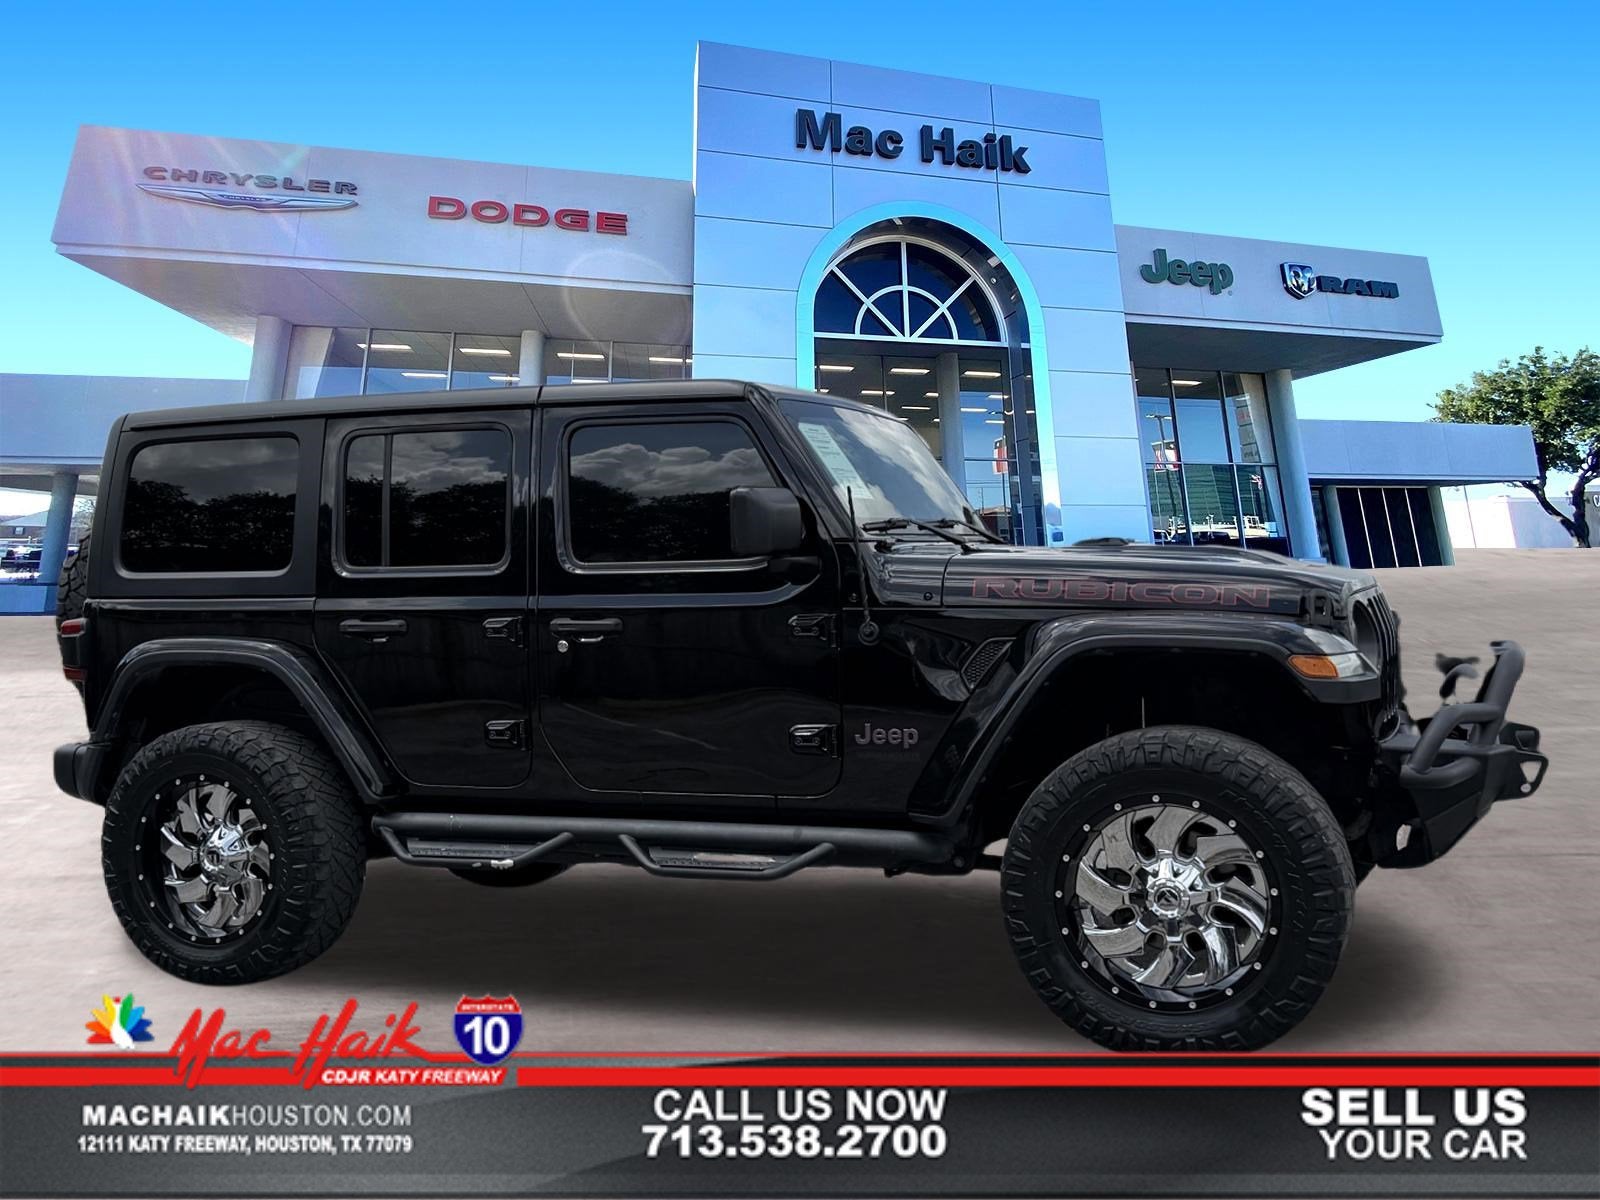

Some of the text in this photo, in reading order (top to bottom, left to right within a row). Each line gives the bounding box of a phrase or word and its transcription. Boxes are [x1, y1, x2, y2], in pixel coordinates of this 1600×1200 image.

[796, 108, 1032, 174] Mac Haik
[142, 165, 359, 196] CHRYSLER
[428, 196, 629, 235] DODGE
[1140, 248, 1234, 296] Jeep
[1315, 275, 1400, 299] RAM
[972, 576, 1270, 608] RUBICON
[854, 723, 919, 749] Jeep
